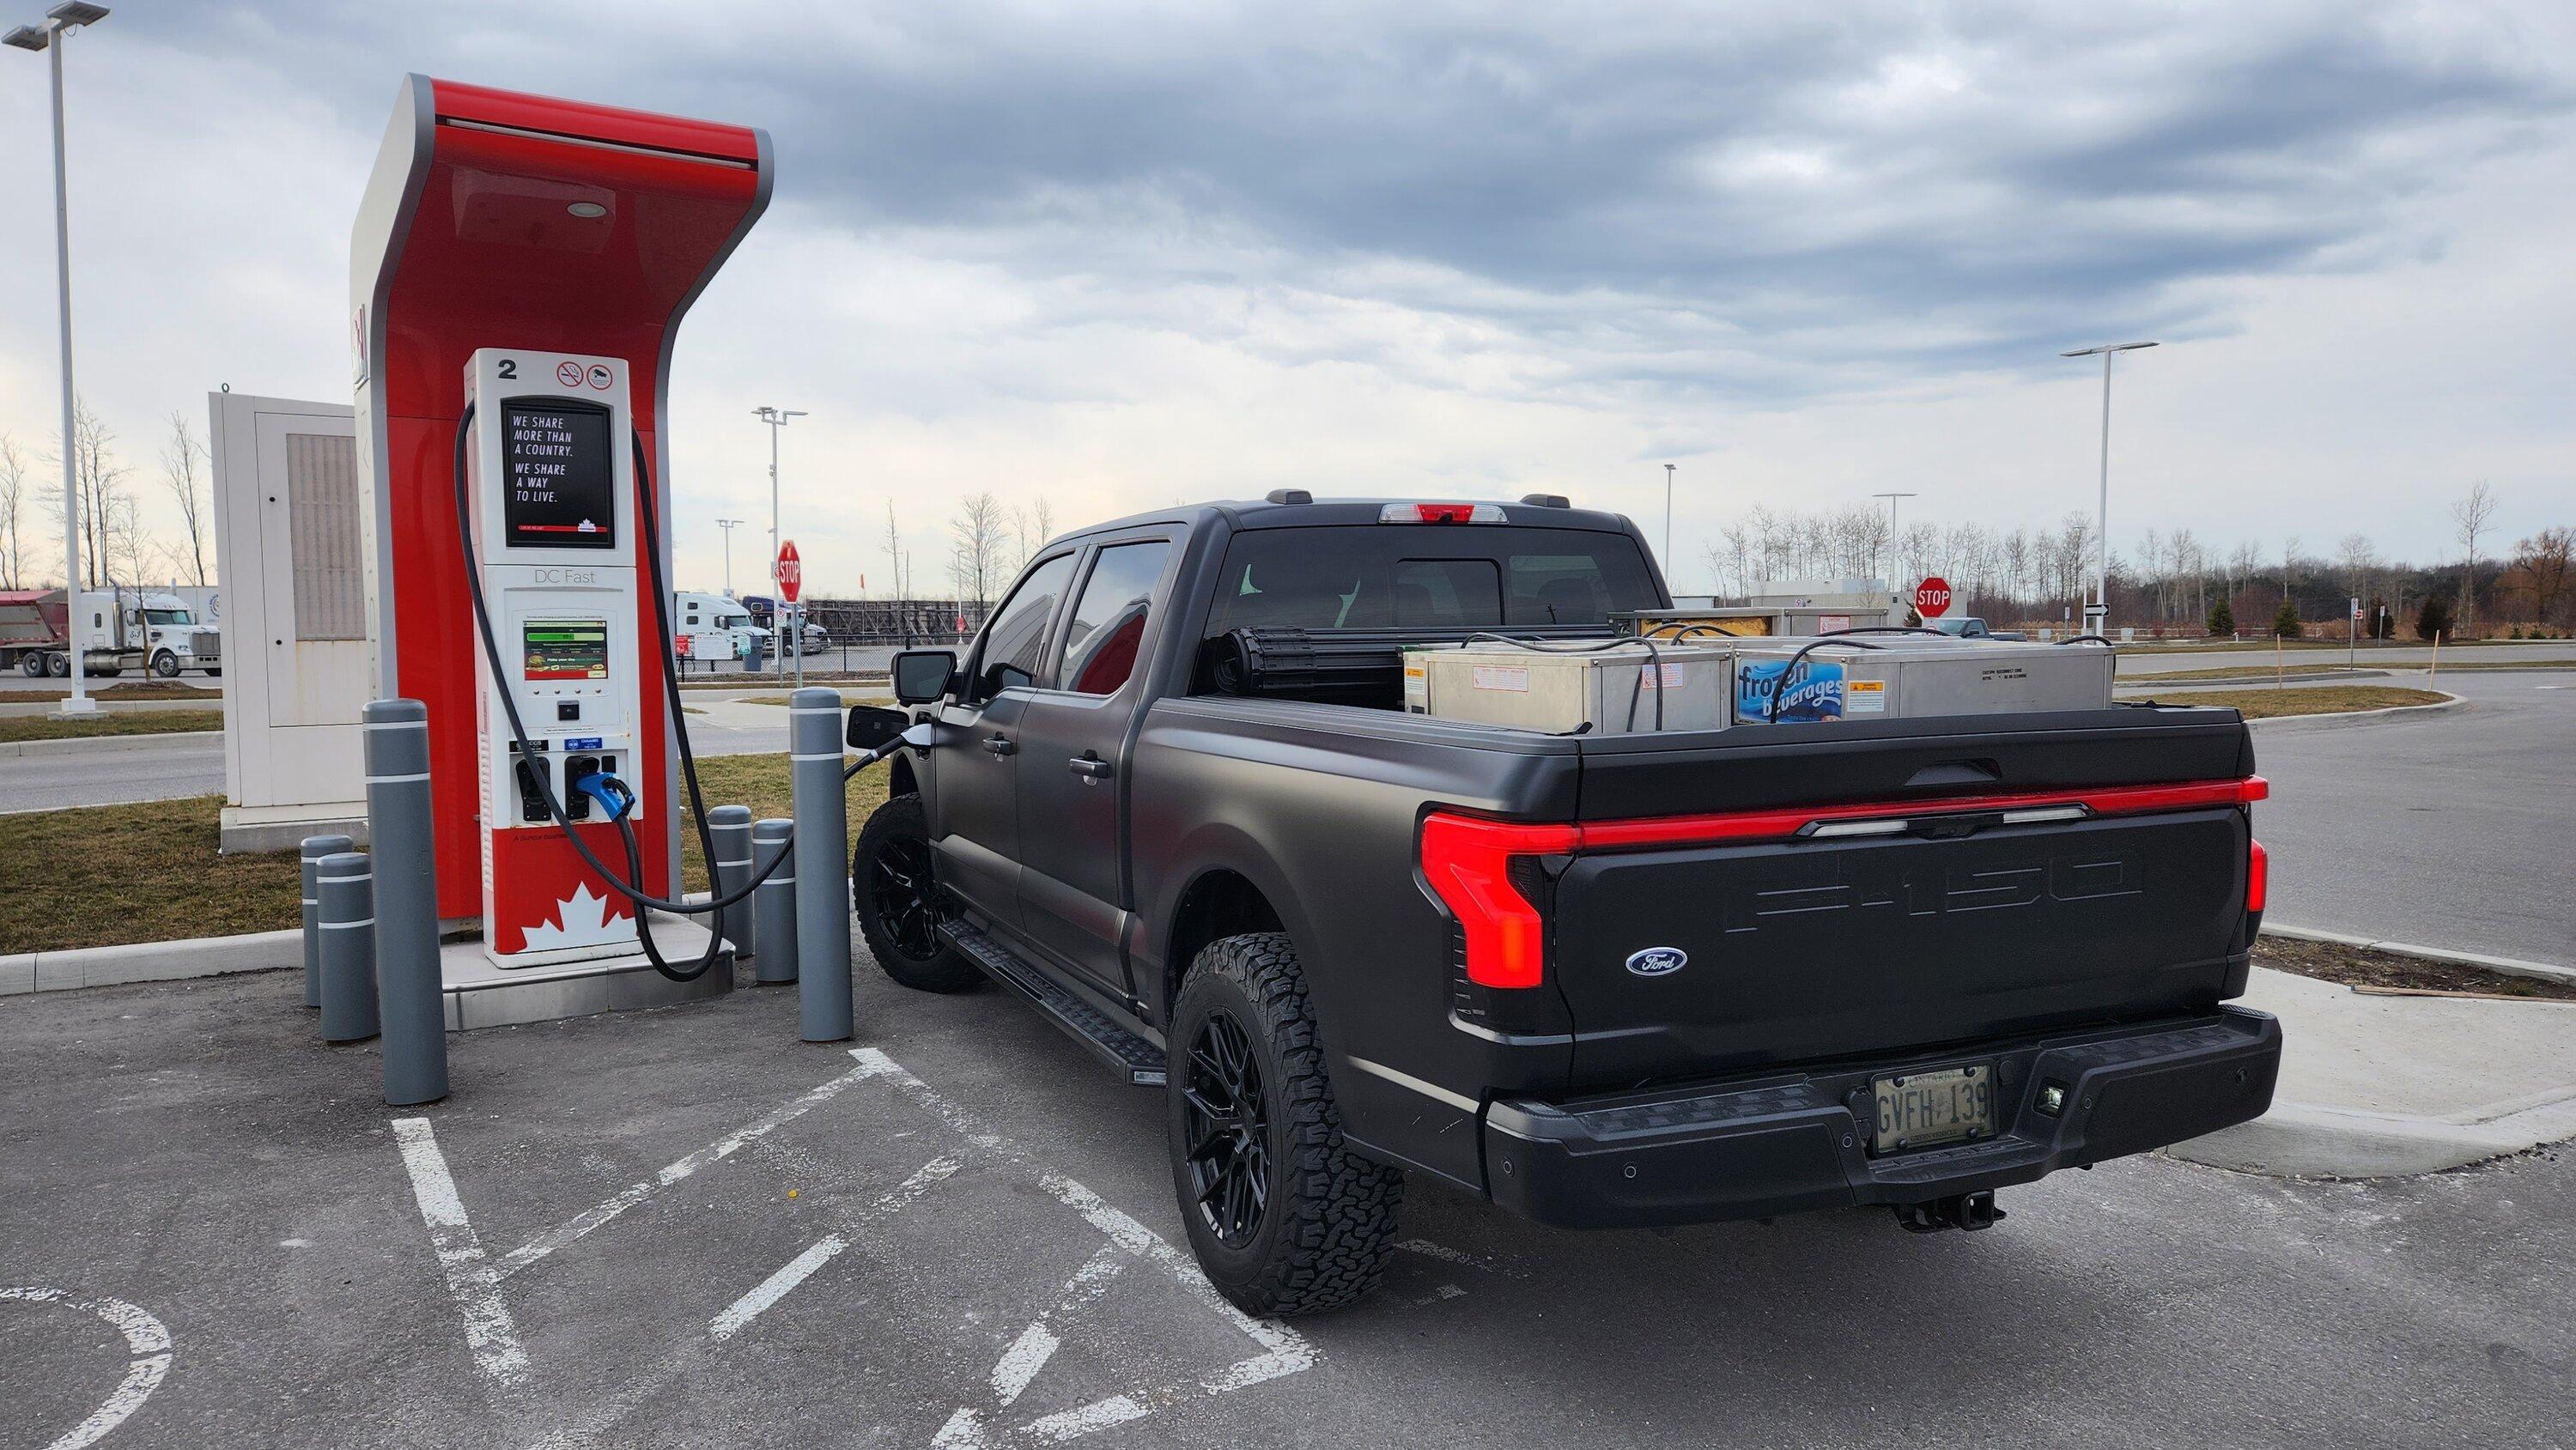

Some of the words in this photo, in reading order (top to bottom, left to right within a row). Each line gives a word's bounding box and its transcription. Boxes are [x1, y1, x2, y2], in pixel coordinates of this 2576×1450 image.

[498, 359, 517, 379] 2
[513, 416, 527, 428] WE
[532, 416, 563, 429] SHARE
[513, 430, 542, 442] MORE
[547, 431, 572, 443] THAN
[514, 444, 521, 455] A
[526, 444, 573, 457] COUNTRY.
[515, 463, 530, 474] WE
[534, 464, 566, 476] SHARE
[516, 477, 522, 488] A
[527, 477, 548, 488] WAY
[516, 490, 528, 501] TO
[533, 491, 558, 502] LIVE.
[535, 569, 560, 584] DC
[565, 569, 596, 584] Fast
[780, 560, 799, 584] STOP
[1917, 590, 1950, 605] STOP
[1763, 680, 1843, 717] bverages
[1724, 856, 2142, 933] F-150
[1642, 954, 1675, 971] Ford
[1908, 1071, 1955, 1088] ONTARIO
[1877, 1089, 1932, 1134] GVFH
[1950, 1082, 1989, 1124] 139
